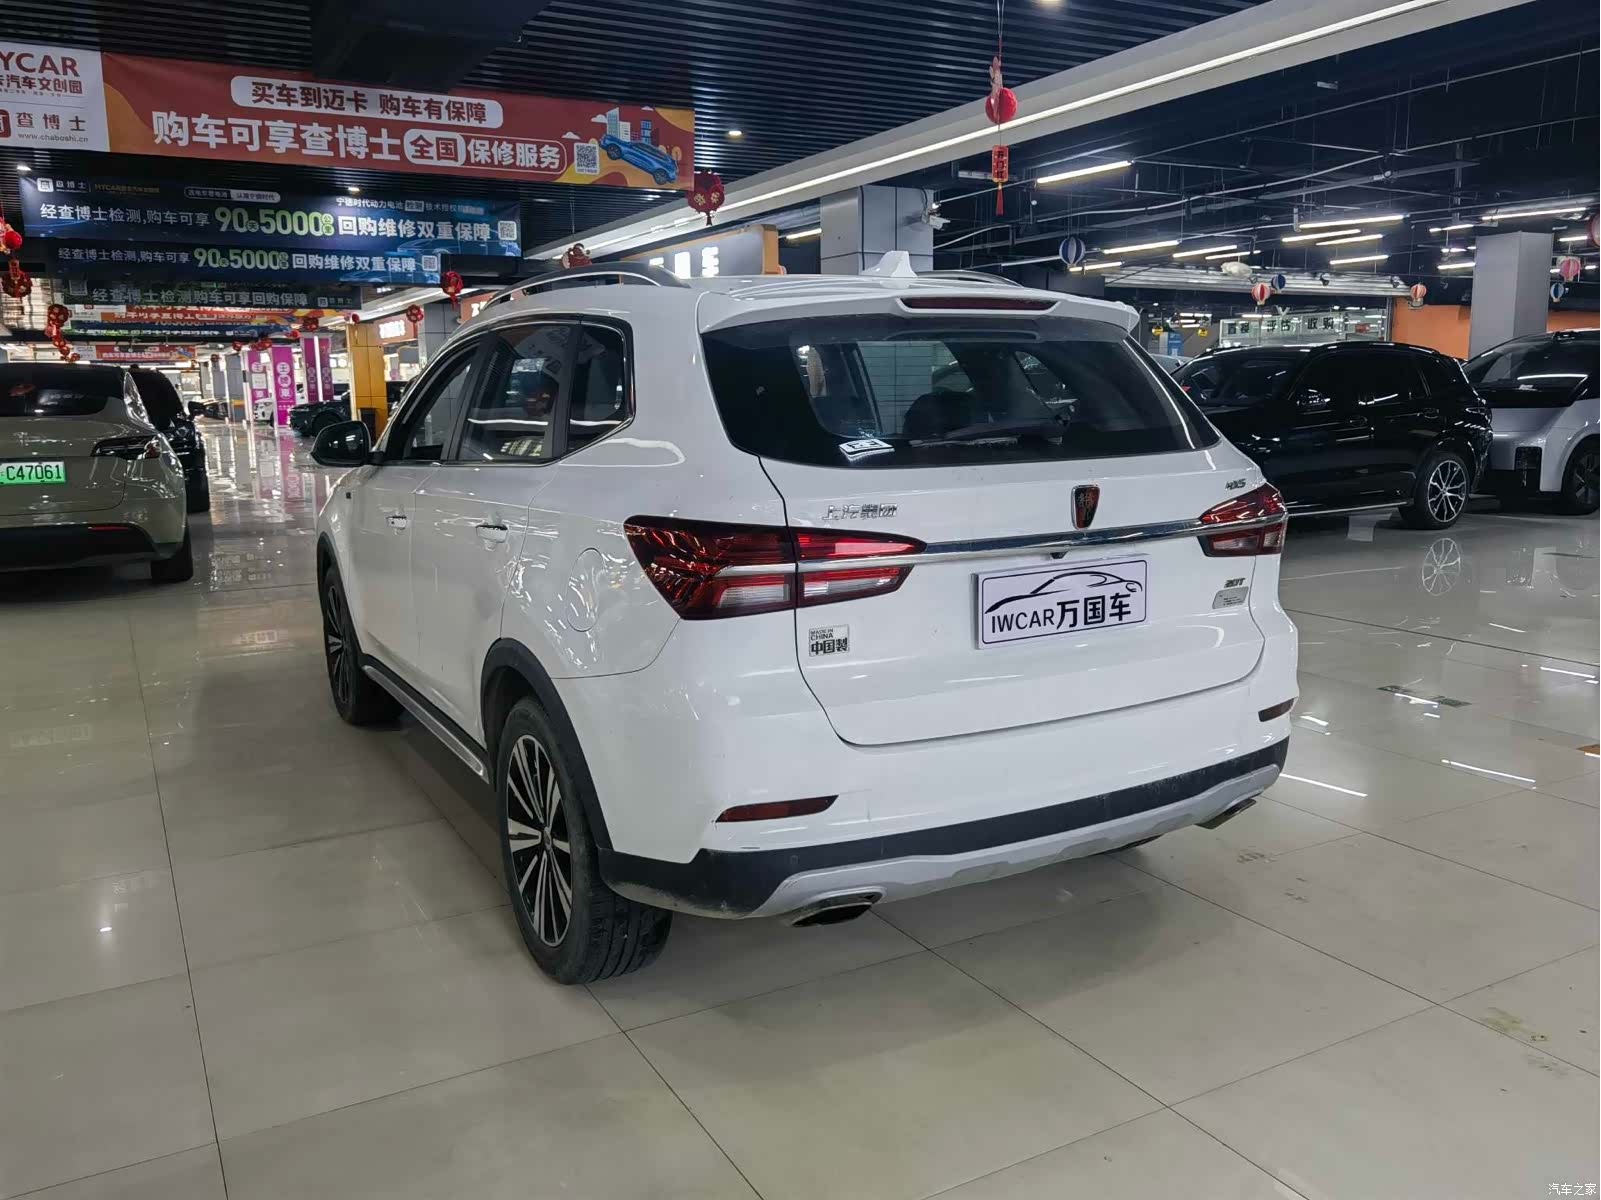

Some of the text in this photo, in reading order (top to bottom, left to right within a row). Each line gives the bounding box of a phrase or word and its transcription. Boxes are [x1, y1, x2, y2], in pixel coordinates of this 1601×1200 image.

[252, 80, 487, 124] 买车到迈卡 购车有保障
[16, 112, 86, 132] 查博士
[6, 464, 62, 481] C47061
[810, 632, 834, 641] CHINA
